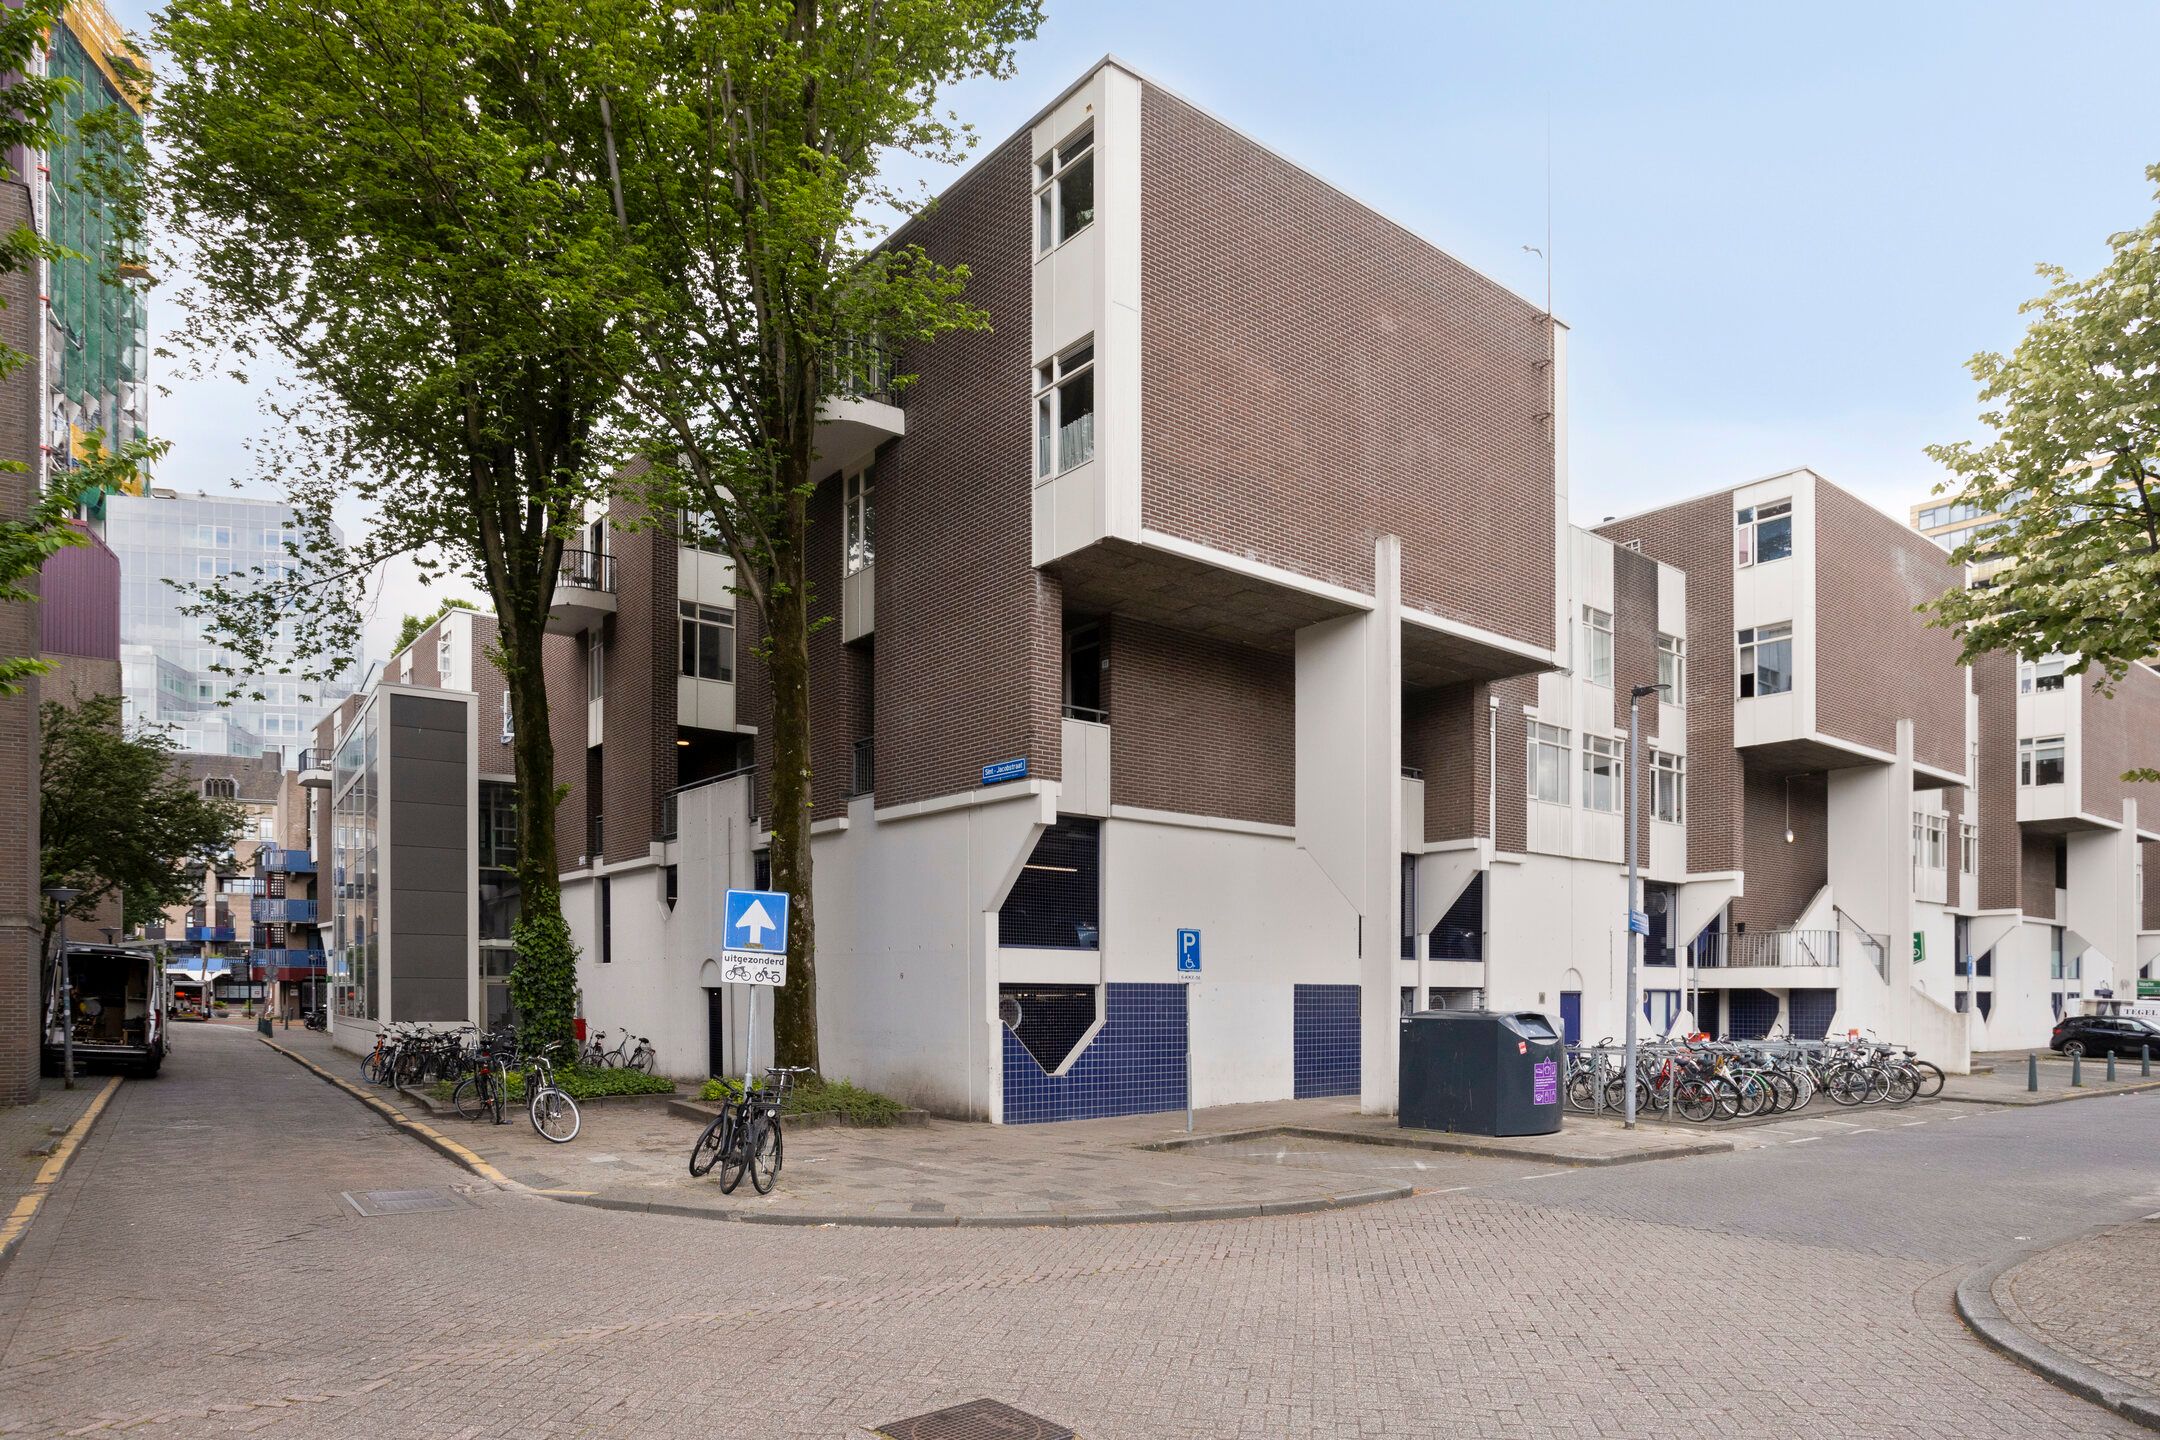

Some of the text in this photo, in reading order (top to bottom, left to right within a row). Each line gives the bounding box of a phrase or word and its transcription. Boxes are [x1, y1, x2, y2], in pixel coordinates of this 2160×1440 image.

[985, 767, 994, 776] Sint
[997, 762, 1023, 774] Jacobstraat
[1184, 933, 1196, 953] P
[724, 954, 784, 965] uitgezonderd
[2124, 1008, 2158, 1016] TEGEL
